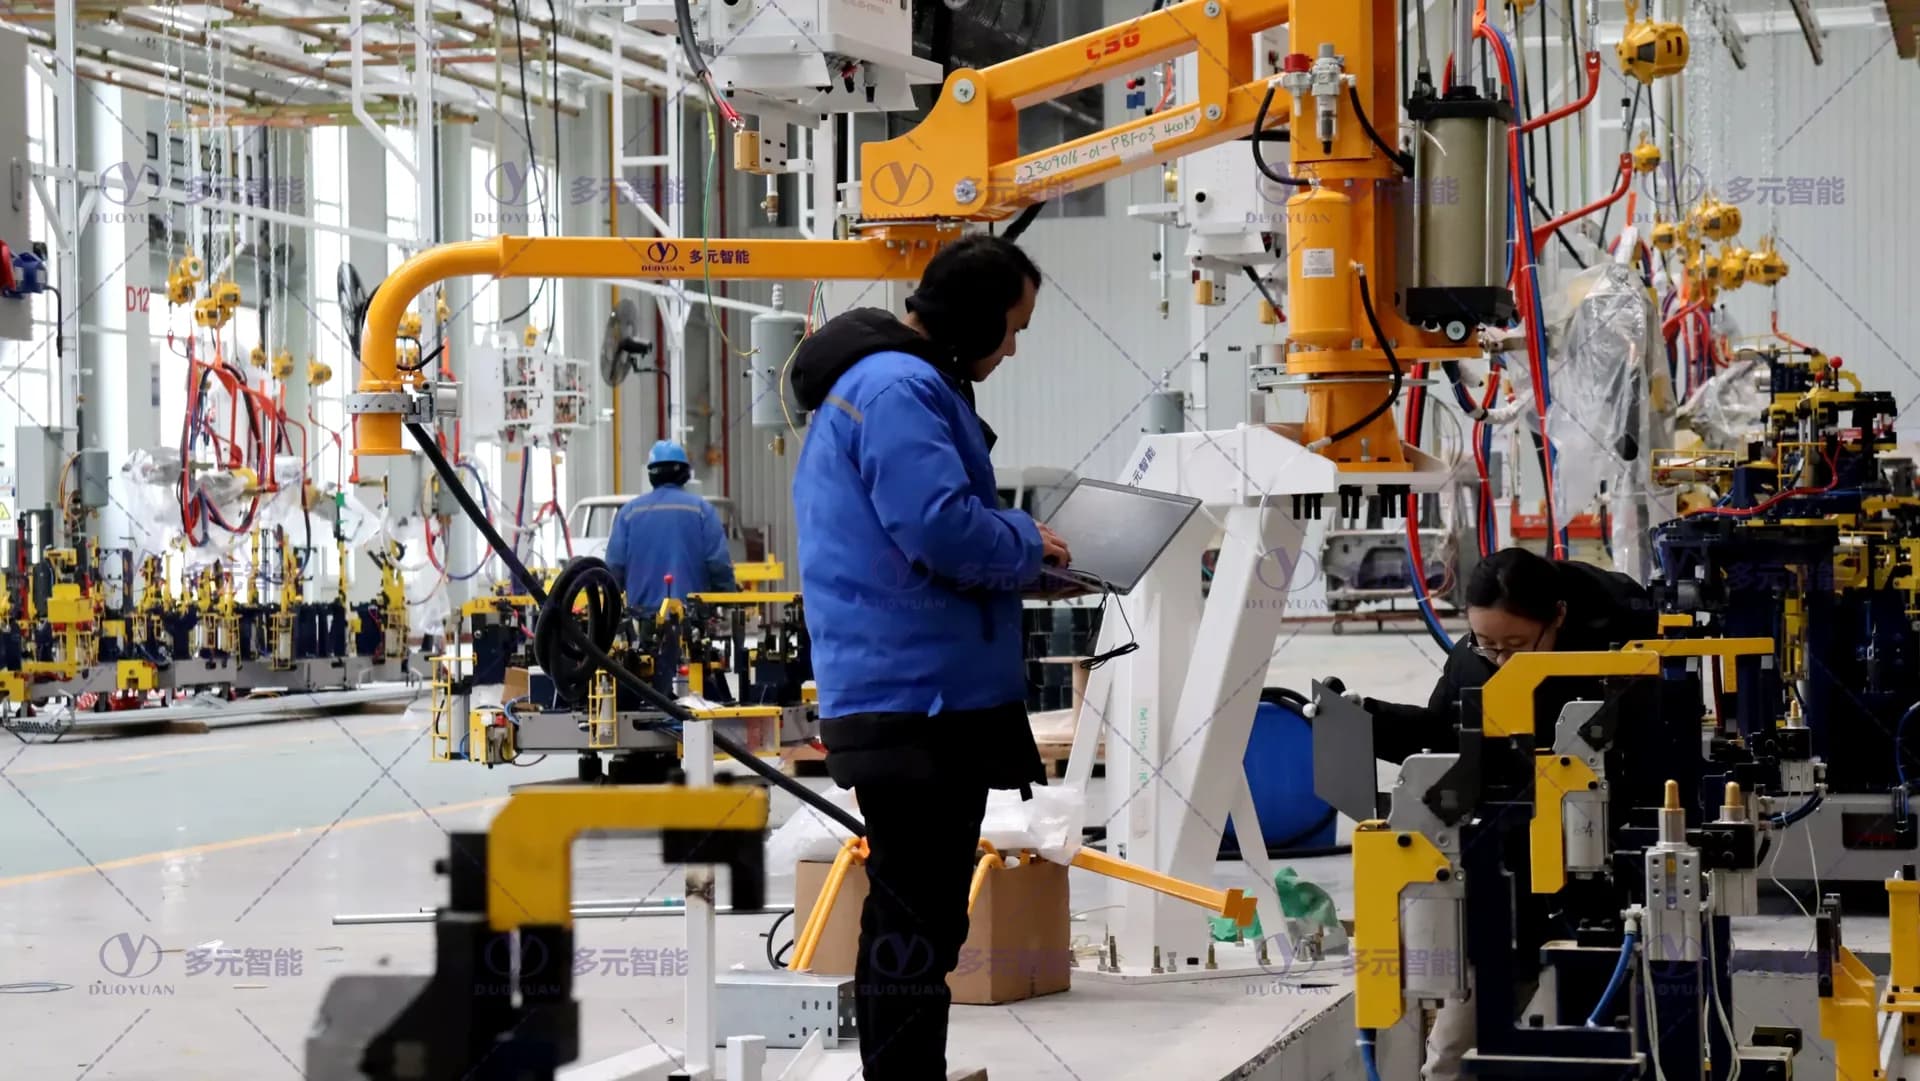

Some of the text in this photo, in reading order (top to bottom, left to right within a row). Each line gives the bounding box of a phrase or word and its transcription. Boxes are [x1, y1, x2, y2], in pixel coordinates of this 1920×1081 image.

[689, 249, 750, 265] 多元智能
[641, 264, 685, 272] DUOYUAN
[126, 286, 150, 313] D12
